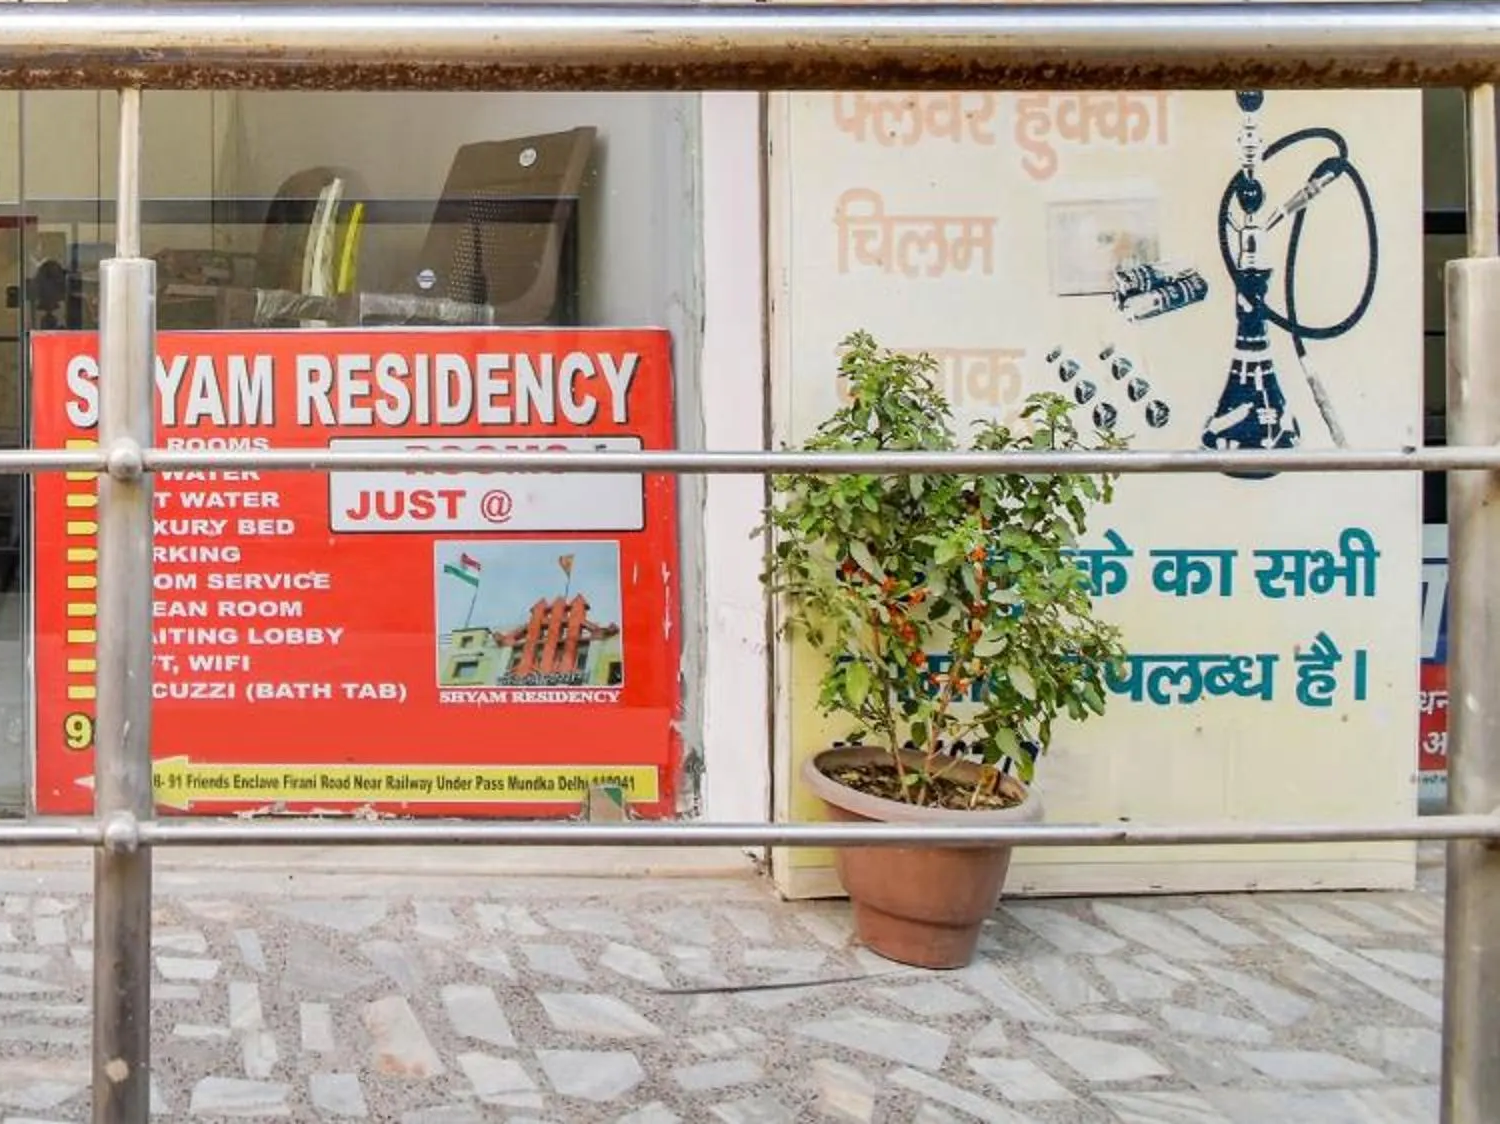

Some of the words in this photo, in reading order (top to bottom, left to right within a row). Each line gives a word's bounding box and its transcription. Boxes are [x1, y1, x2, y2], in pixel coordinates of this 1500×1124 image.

[834, 188, 998, 277] चिलम
[65, 354, 275, 428] SYAM
[296, 351, 641, 426] RESIDENCY
[180, 492, 281, 508] WATER
[345, 489, 467, 521] JUST
[480, 489, 513, 523] @
[153, 519, 228, 535] XURY
[237, 519, 296, 535] BED
[153, 546, 242, 563] RKING
[1150, 549, 1238, 598] का
[1252, 527, 1381, 598] सभी
[153, 573, 198, 589] OM
[207, 572, 331, 590] SERVICE
[152, 601, 208, 617] EAN
[217, 601, 304, 617] ROOM
[248, 627, 344, 645] LOBBY
[188, 655, 251, 672] WIFI
[1088, 649, 1280, 705] पलब्ध
[152, 683, 236, 699] CUZZI
[245, 682, 332, 703] (BATH
[341, 682, 409, 703] TAB)
[439, 690, 508, 705] SHYAM
[511, 690, 621, 704] RESIDENCY
[186, 773, 231, 790] Friends
[233, 774, 280, 790] Enclave
[321, 774, 350, 790] Road
[353, 774, 382, 790] Near
[385, 774, 433, 794] Railway
[436, 775, 472, 791] Under
[475, 775, 504, 791] Pass
[507, 775, 555, 791] Mundka
